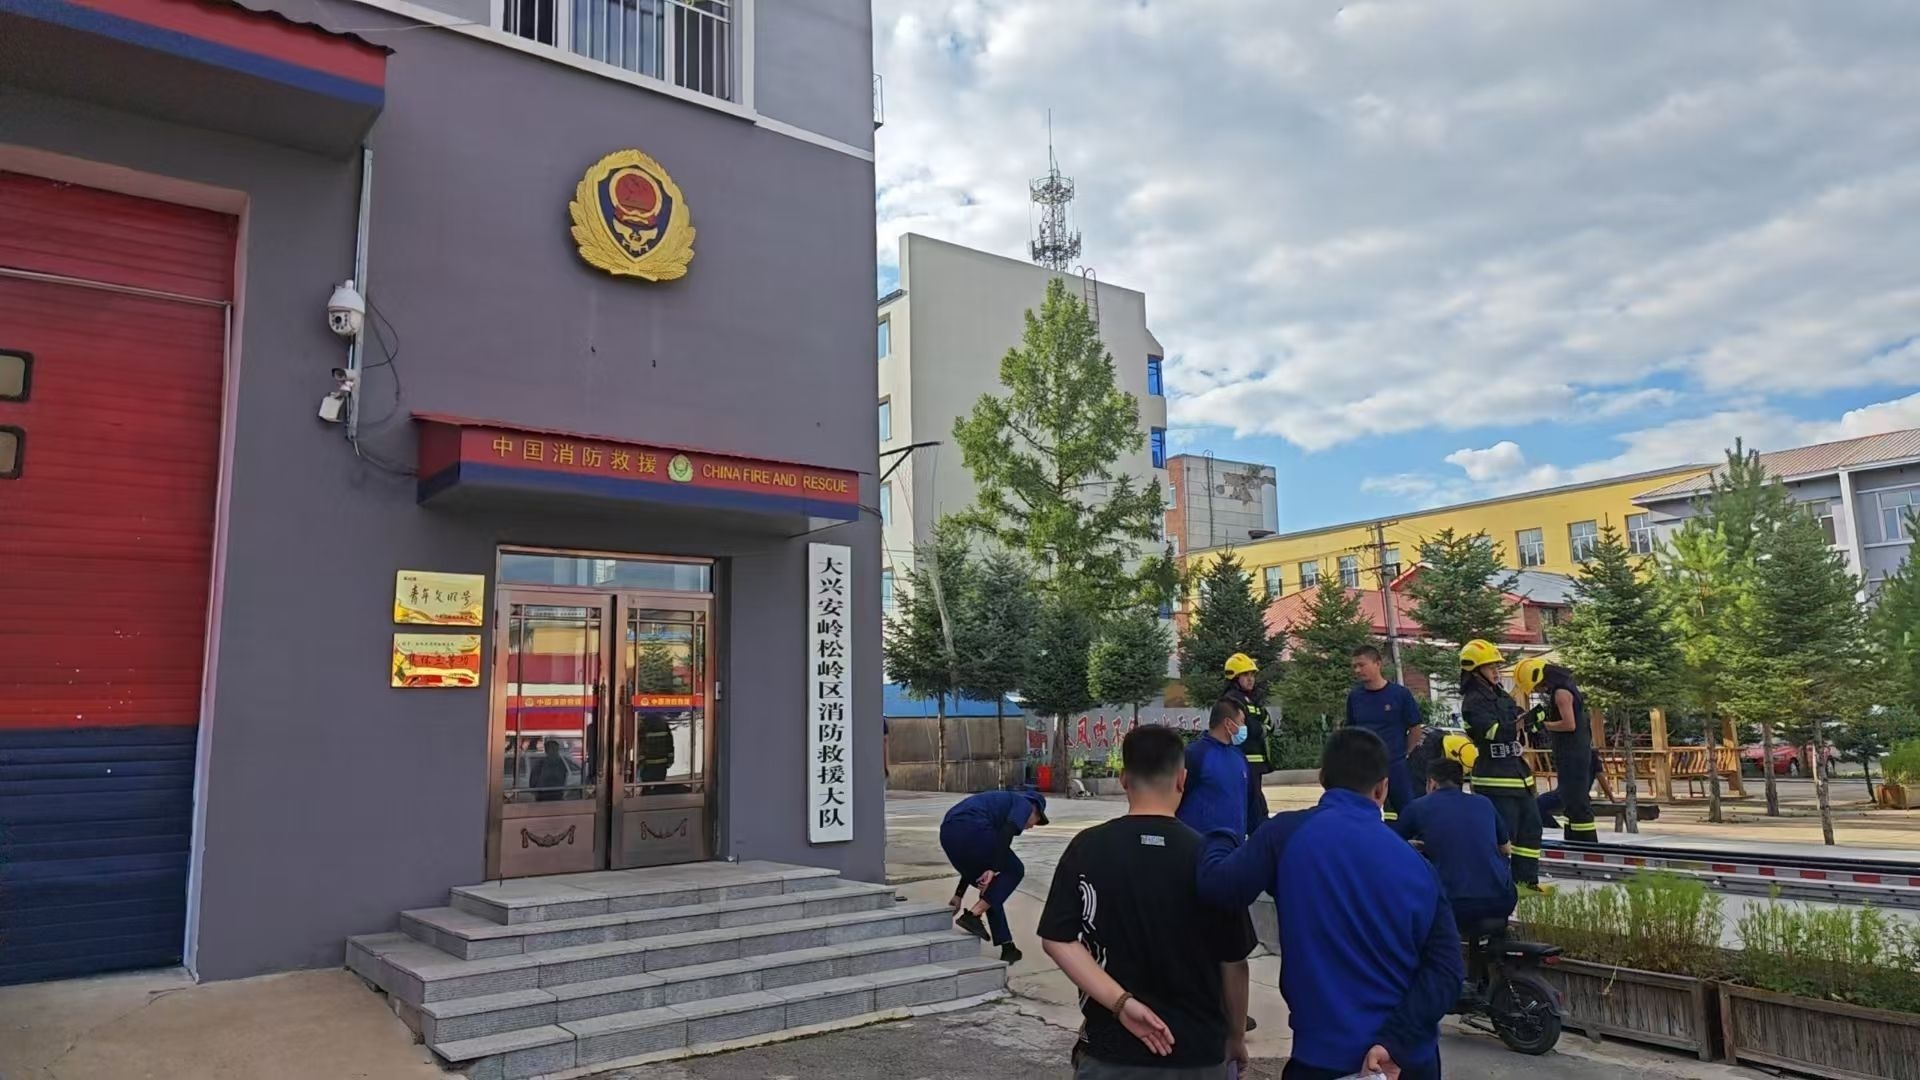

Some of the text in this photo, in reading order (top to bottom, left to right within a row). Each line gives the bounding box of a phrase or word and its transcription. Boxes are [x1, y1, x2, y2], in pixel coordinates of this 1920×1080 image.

[493, 435, 657, 474] 中国消防救援
[702, 463, 848, 493] CHINA FIRE AND RESCUE
[409, 584, 470, 608] 青年文明号
[817, 556, 845, 829] 大兴安岭松岭区消防救援大队
